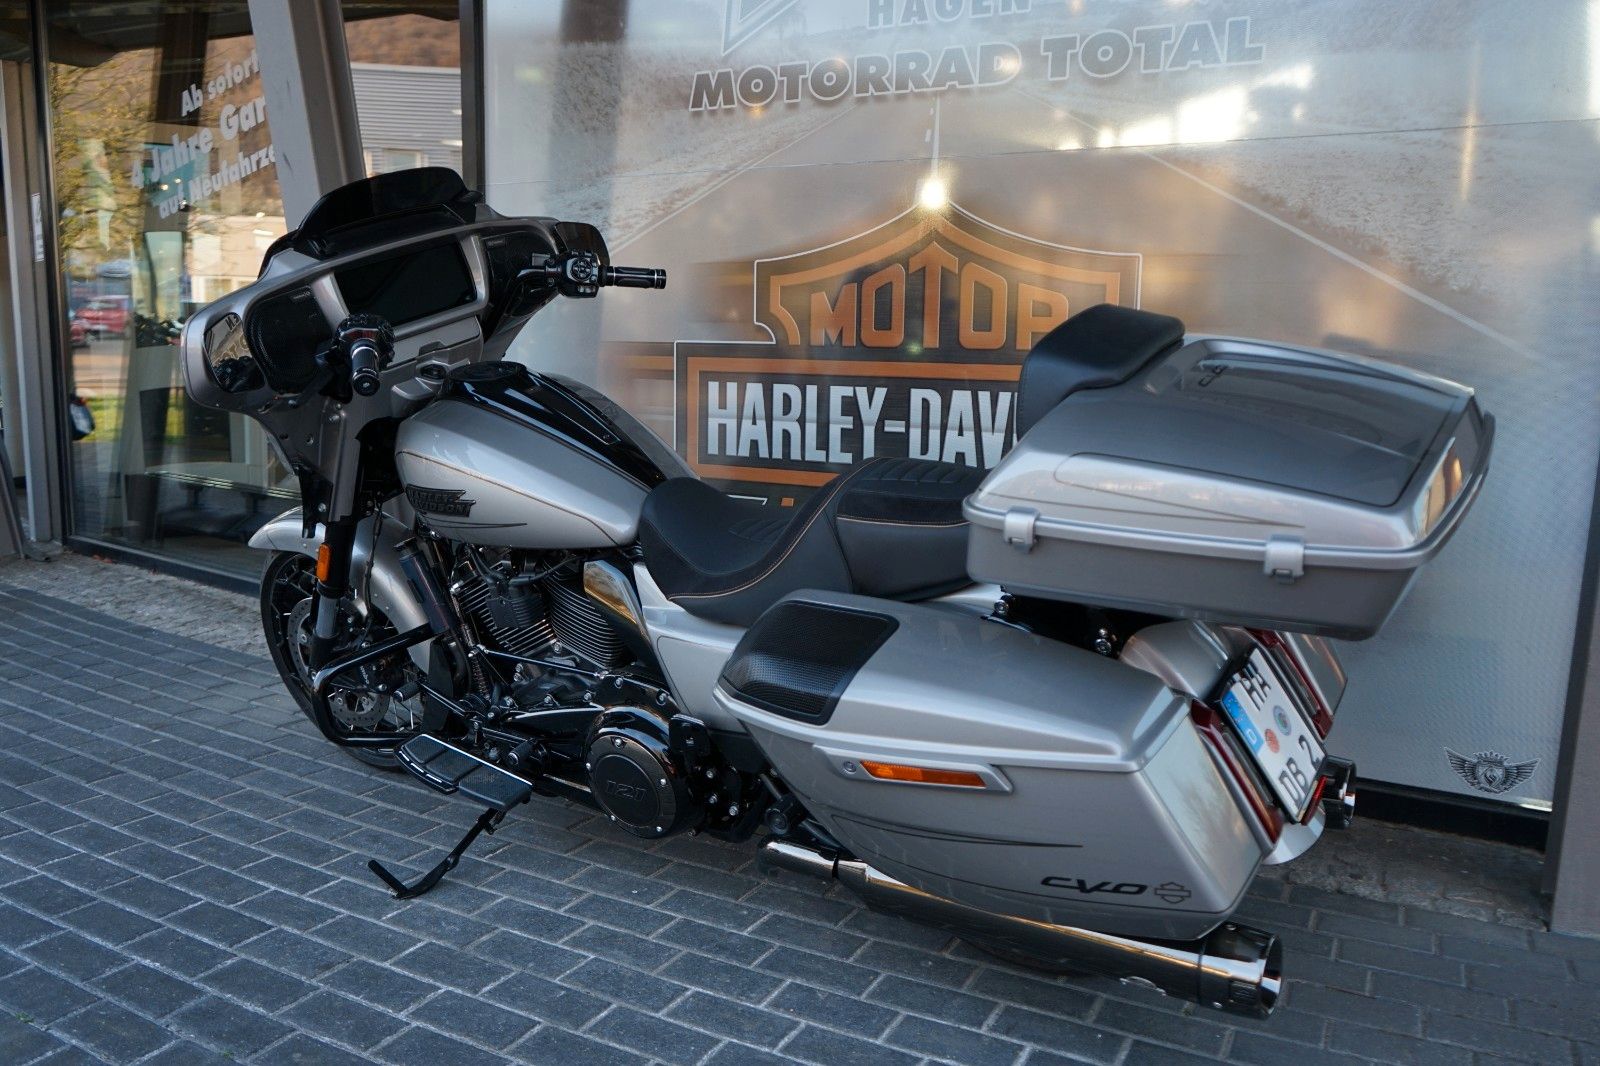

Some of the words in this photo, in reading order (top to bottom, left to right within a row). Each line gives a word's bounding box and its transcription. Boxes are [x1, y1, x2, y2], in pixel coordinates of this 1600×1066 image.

[689, 42, 1022, 111] MOTORRAD
[1041, 16, 1265, 81] TOTAL
[181, 83, 203, 117] Ab
[149, 127, 213, 183] Jahre
[158, 186, 186, 219] auf
[707, 380, 1018, 470] HARLEY-DAV
[1278, 757, 1309, 813] DB
[1298, 734, 1321, 770] 2
[1041, 876, 1148, 894] CVO
